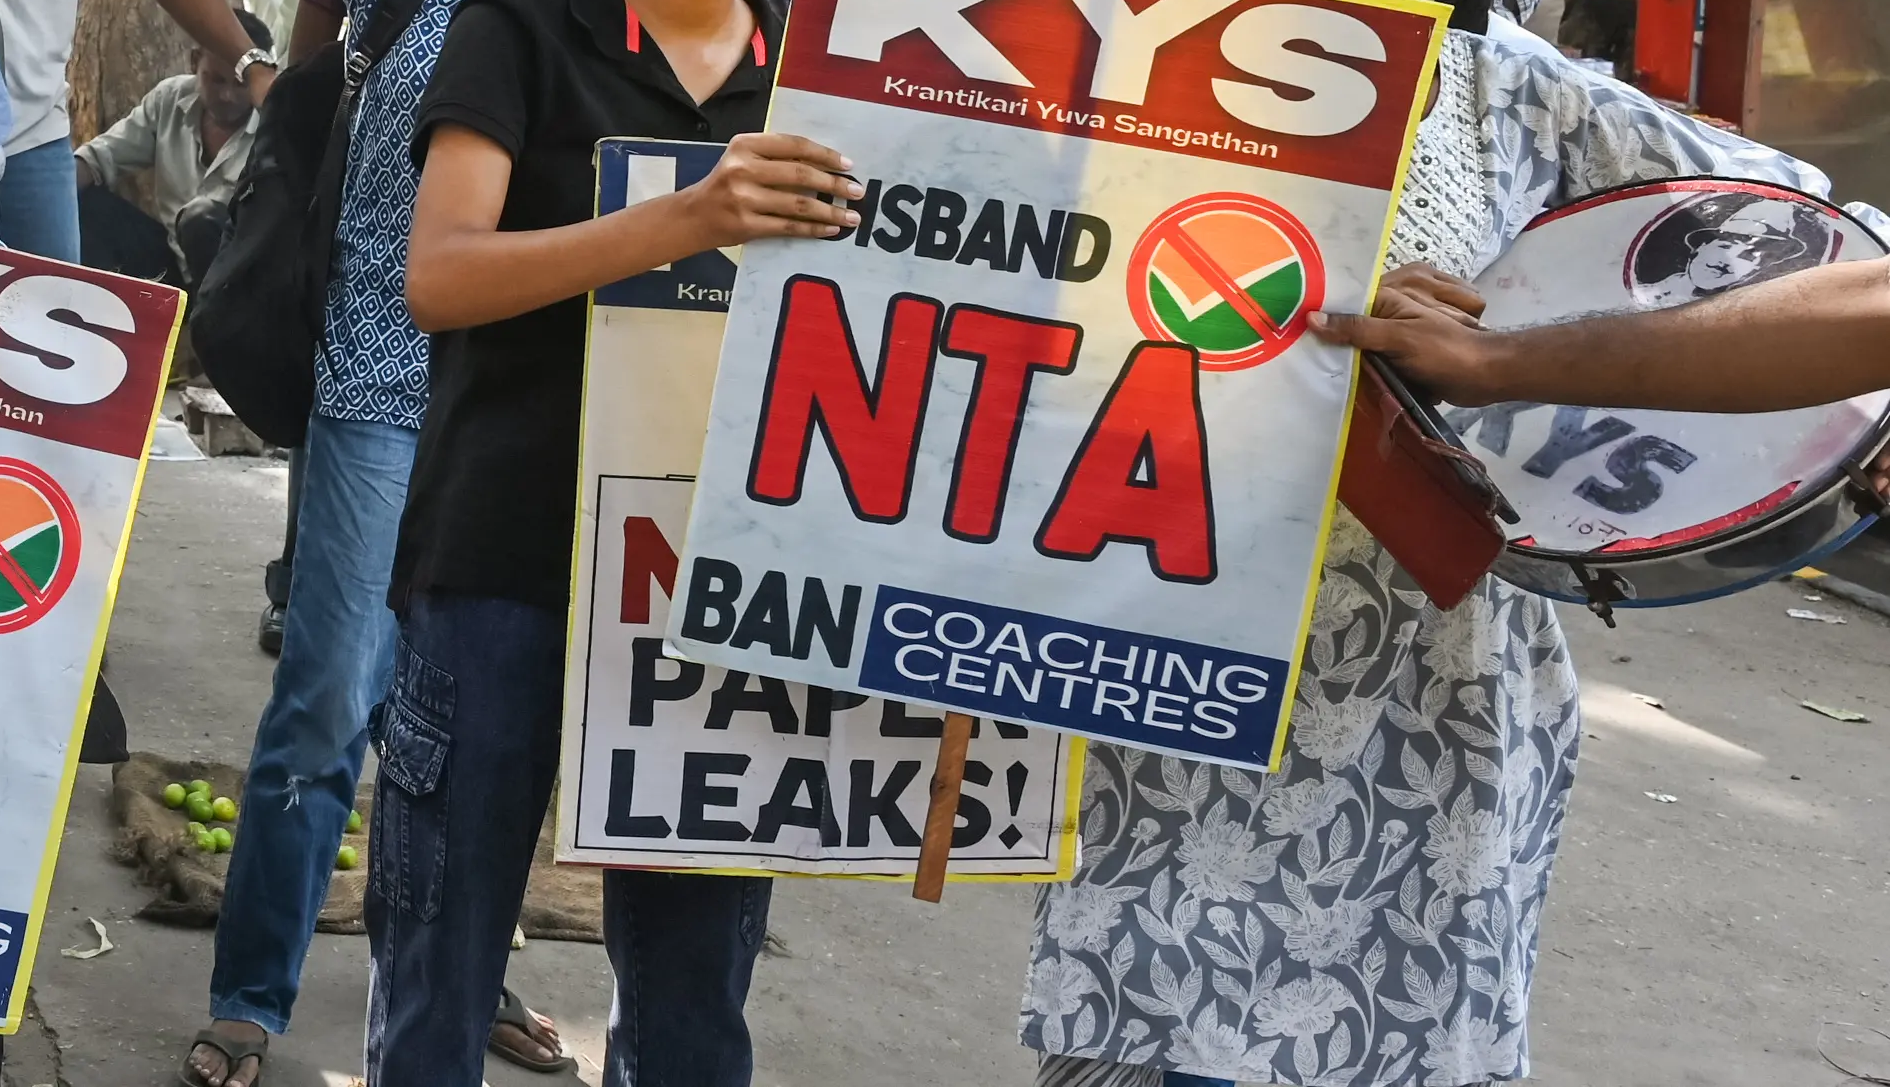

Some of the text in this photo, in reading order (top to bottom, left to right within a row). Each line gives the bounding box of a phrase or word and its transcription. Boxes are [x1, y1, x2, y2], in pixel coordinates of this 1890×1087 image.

[882, 74, 1279, 162] Krantikari Yuva Sangathan
[746, 274, 1218, 586] NTA
[681, 556, 862, 669] BAN
[882, 601, 1271, 703] COACHING
[894, 644, 1239, 742] CENTRES
[604, 749, 1028, 850] LEAKS!
